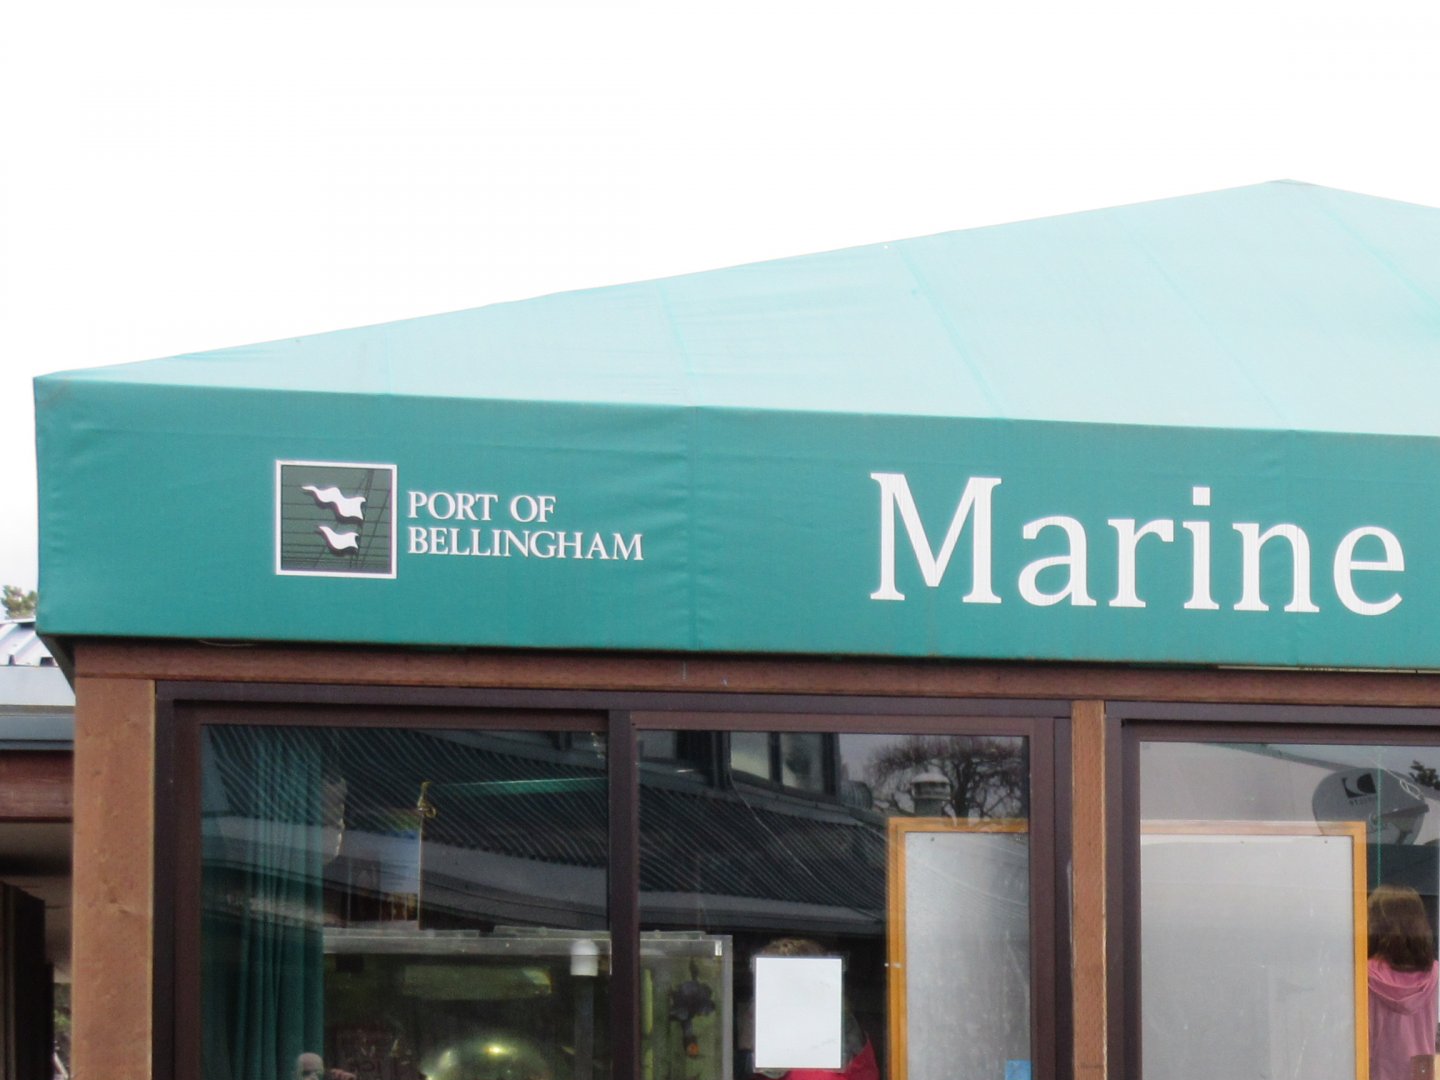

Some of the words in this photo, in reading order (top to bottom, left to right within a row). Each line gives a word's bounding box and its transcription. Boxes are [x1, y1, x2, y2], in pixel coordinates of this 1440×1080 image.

[408, 491, 498, 521] PORT
[510, 494, 556, 523] OF
[408, 526, 644, 561] BELLINGHAM
[870, 472, 1405, 616] Marine
